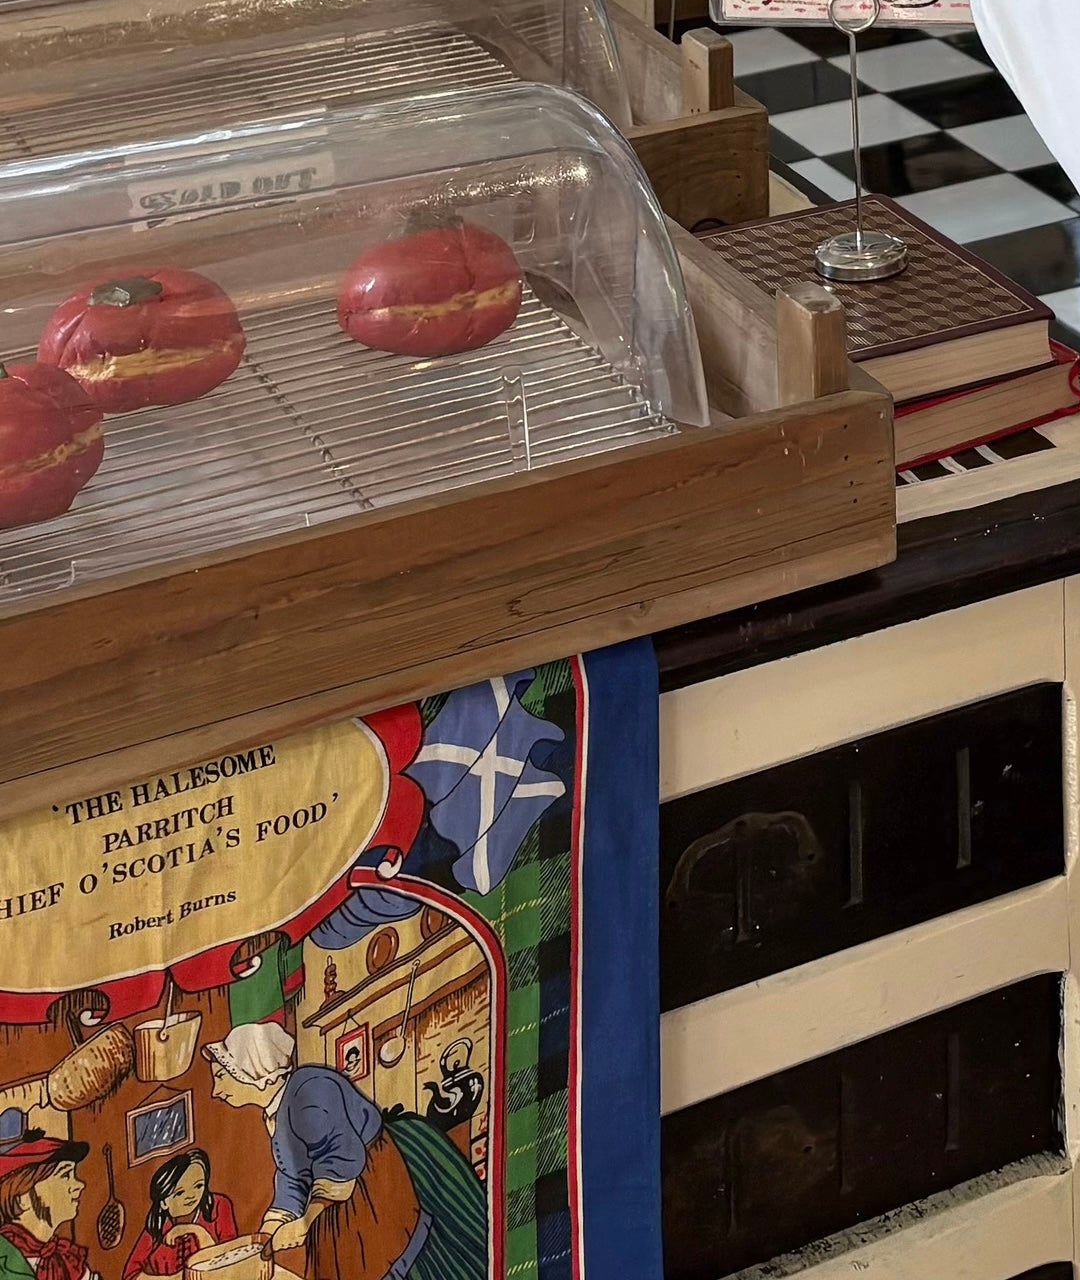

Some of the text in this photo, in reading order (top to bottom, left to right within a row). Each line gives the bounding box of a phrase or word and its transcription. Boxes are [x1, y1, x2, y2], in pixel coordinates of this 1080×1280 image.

[132, 744, 277, 807] HALESOME
[102, 796, 235, 854] PARRITCH
[108, 891, 237, 940] Robert Burns
